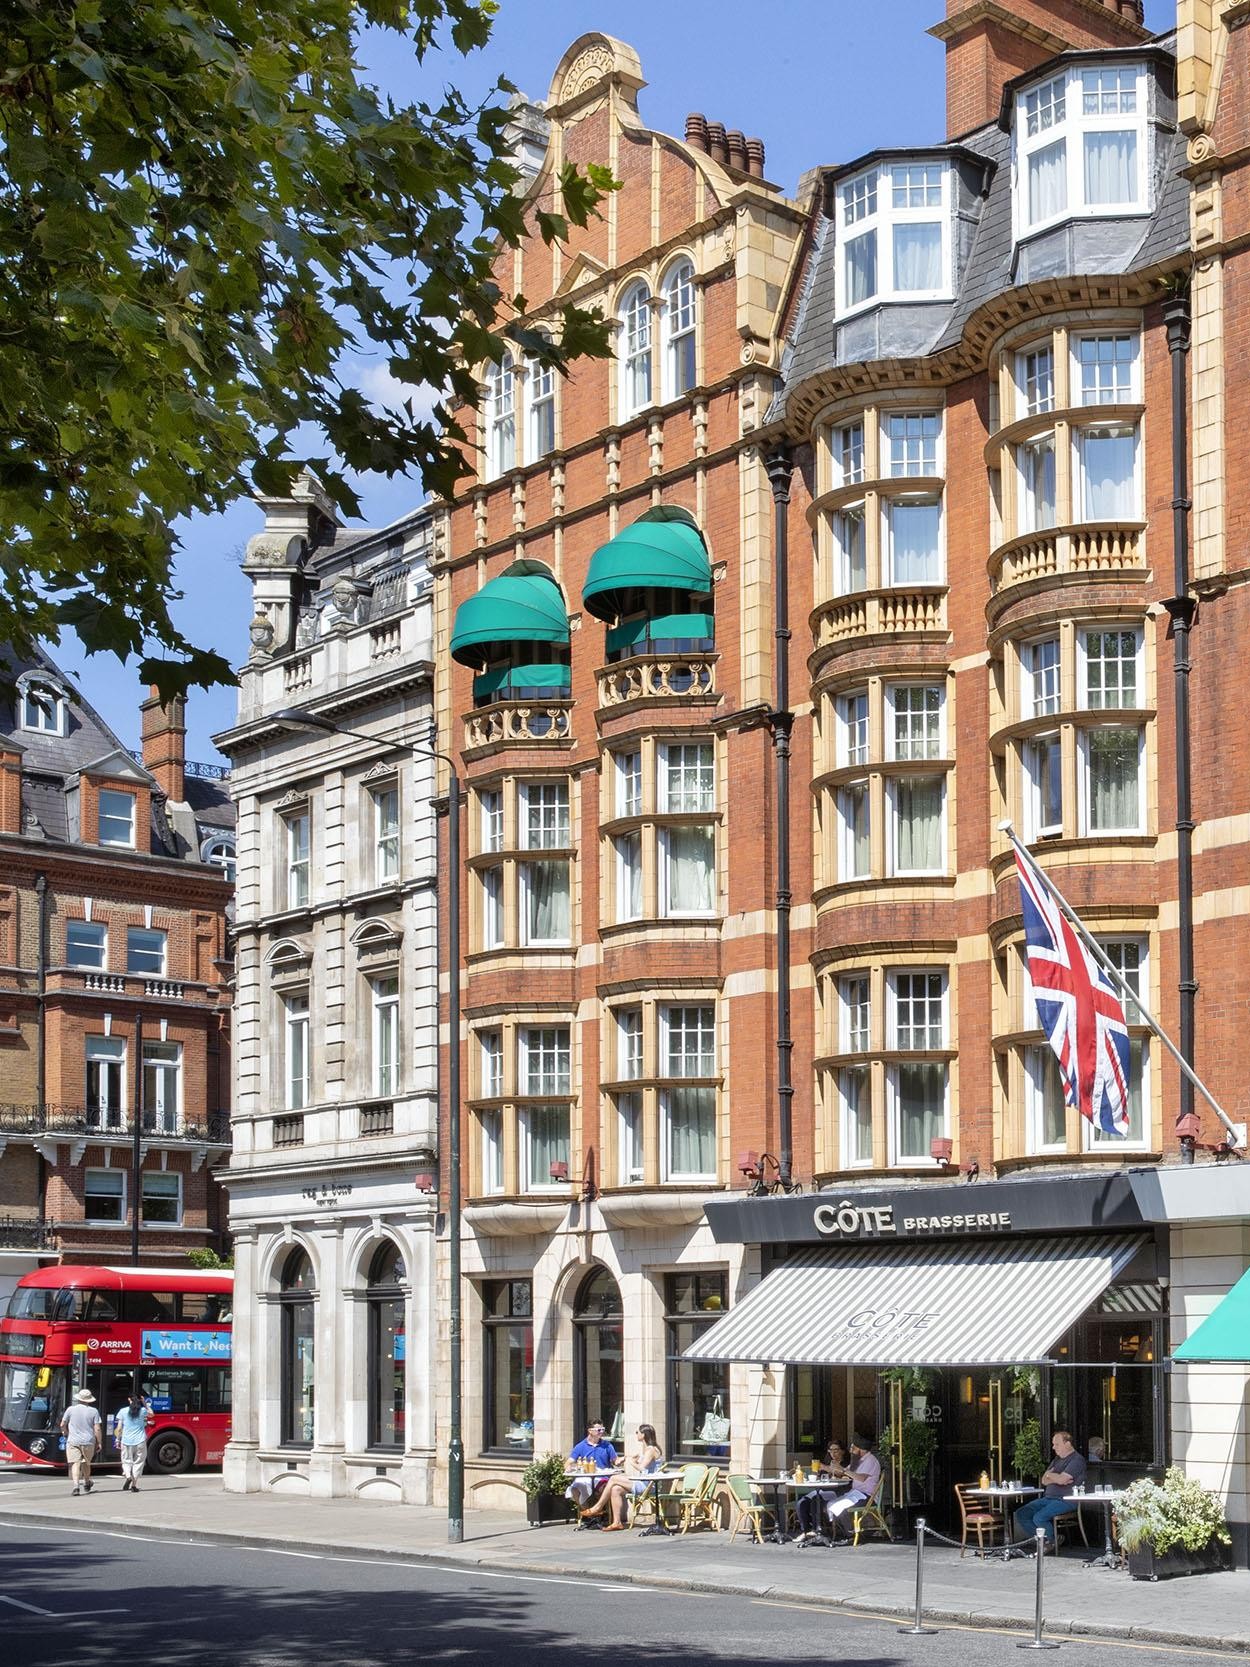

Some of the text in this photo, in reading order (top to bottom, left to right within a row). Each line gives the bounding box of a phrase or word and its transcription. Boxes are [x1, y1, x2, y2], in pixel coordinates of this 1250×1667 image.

[813, 1200, 1011, 1234] CÔTE BRASSERIE
[847, 1306, 940, 1329] CÔTE
[100, 1340, 132, 1348] ARRIVA
[159, 1340, 191, 1350] Want
[148, 1370, 156, 1378] 19
